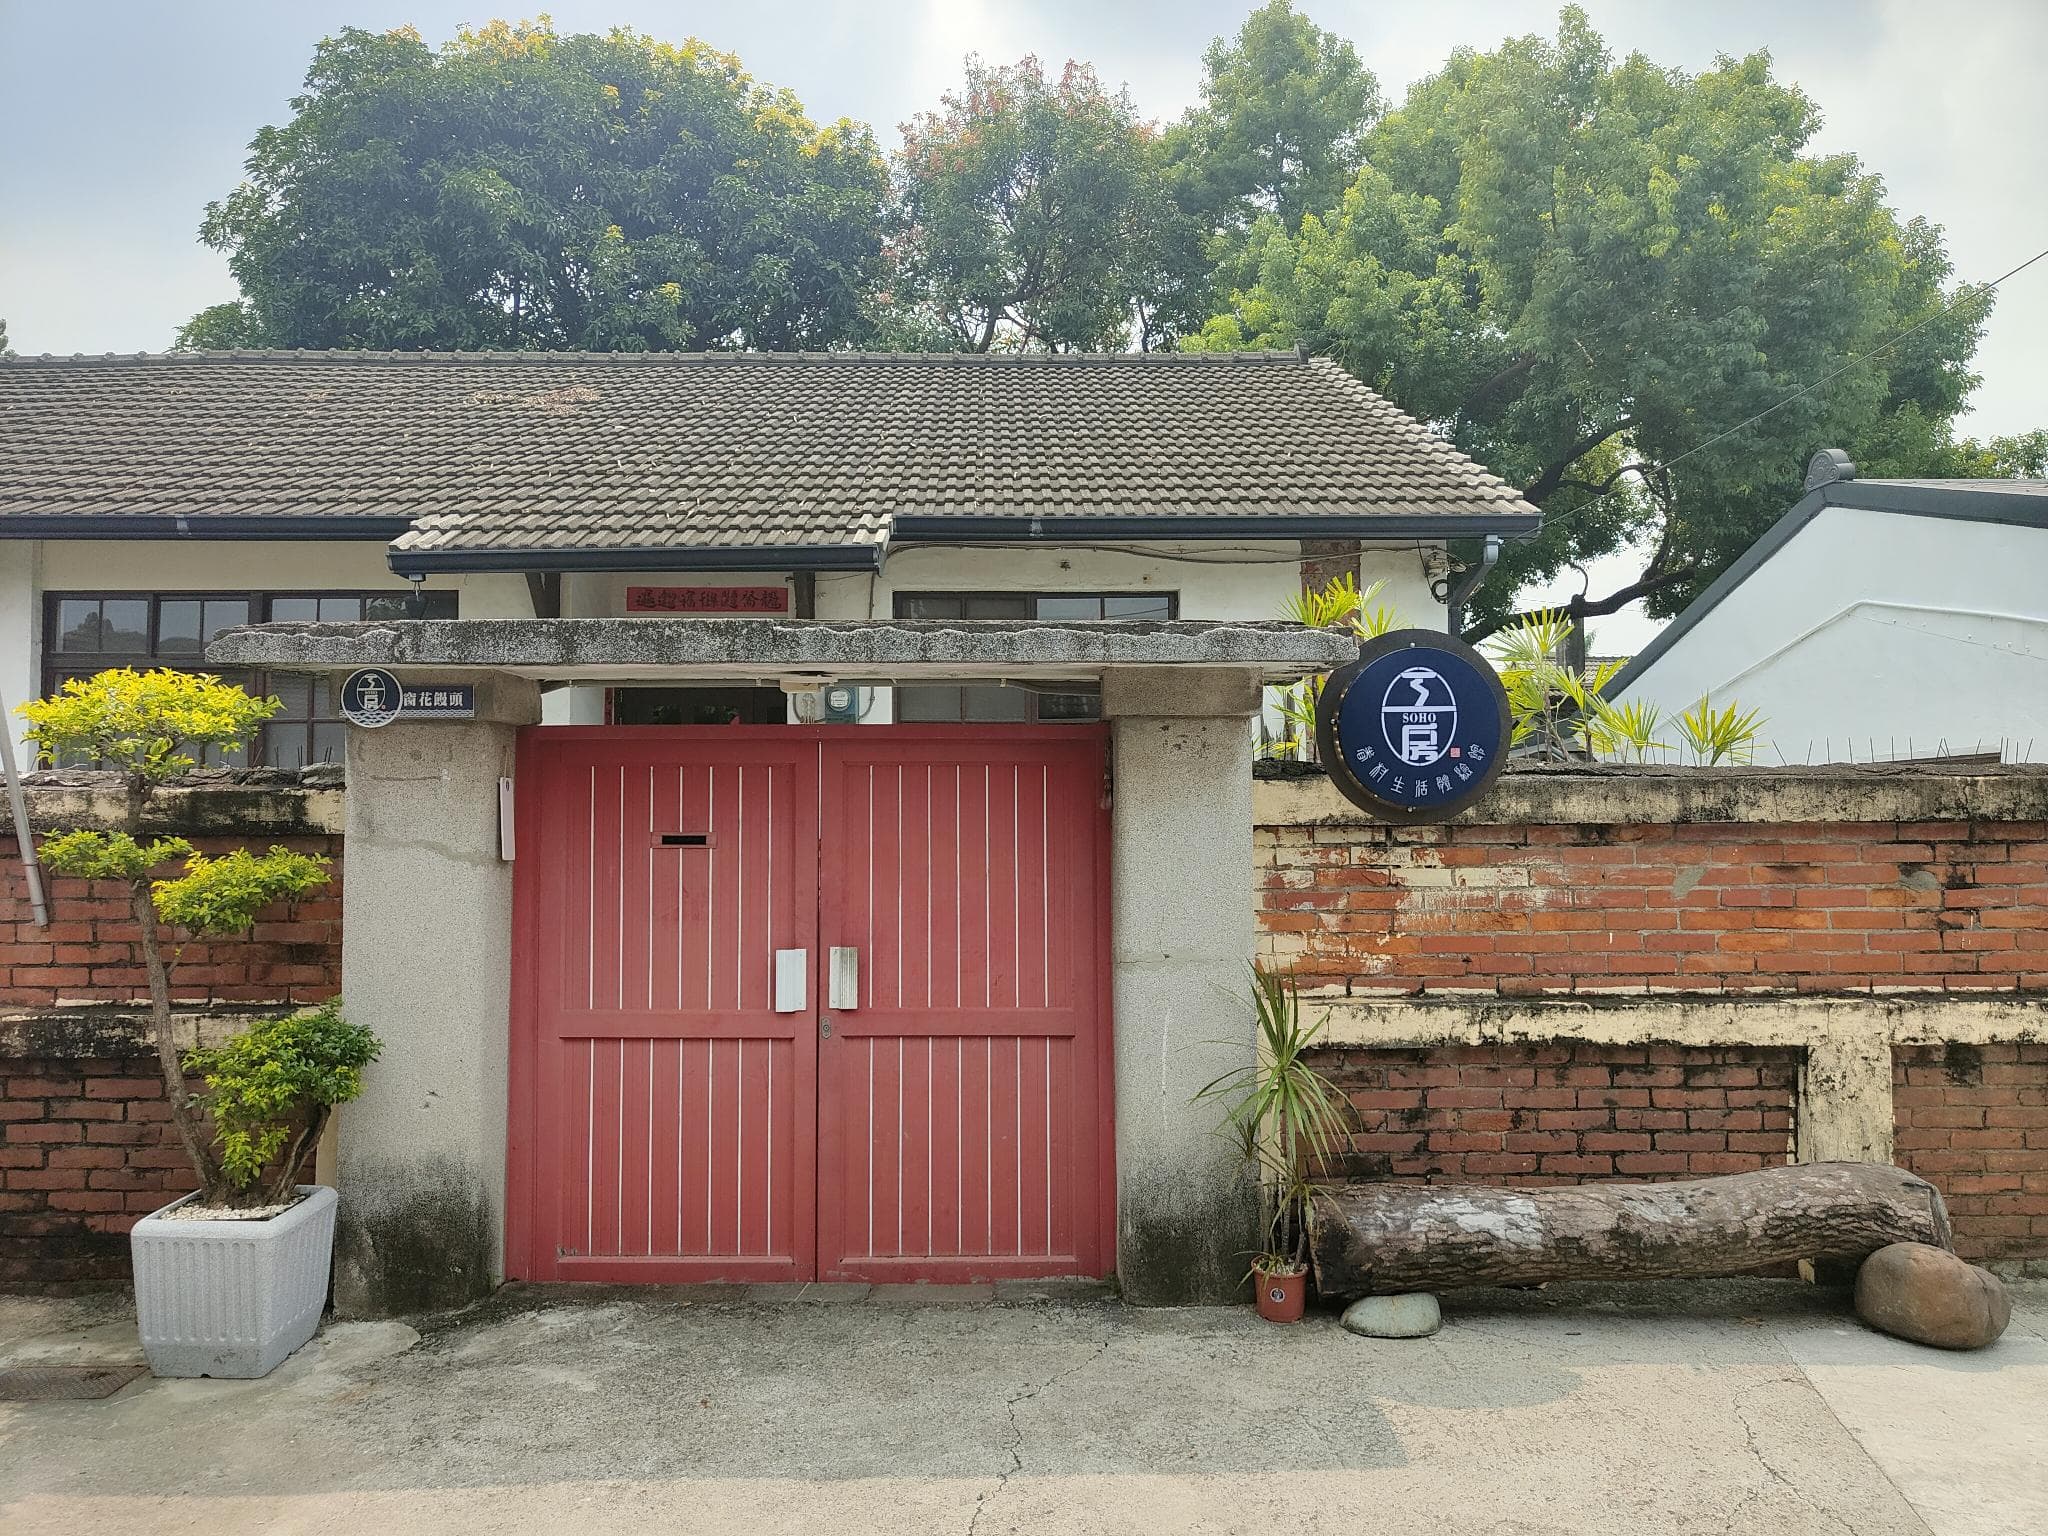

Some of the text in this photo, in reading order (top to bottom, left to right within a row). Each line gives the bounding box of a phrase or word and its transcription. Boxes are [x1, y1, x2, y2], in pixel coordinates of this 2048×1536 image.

[403, 691, 464, 707] 窗花饅頭
[1402, 712, 1437, 724] SOHO
[1356, 743, 1487, 798] 眷村生活體驗館
